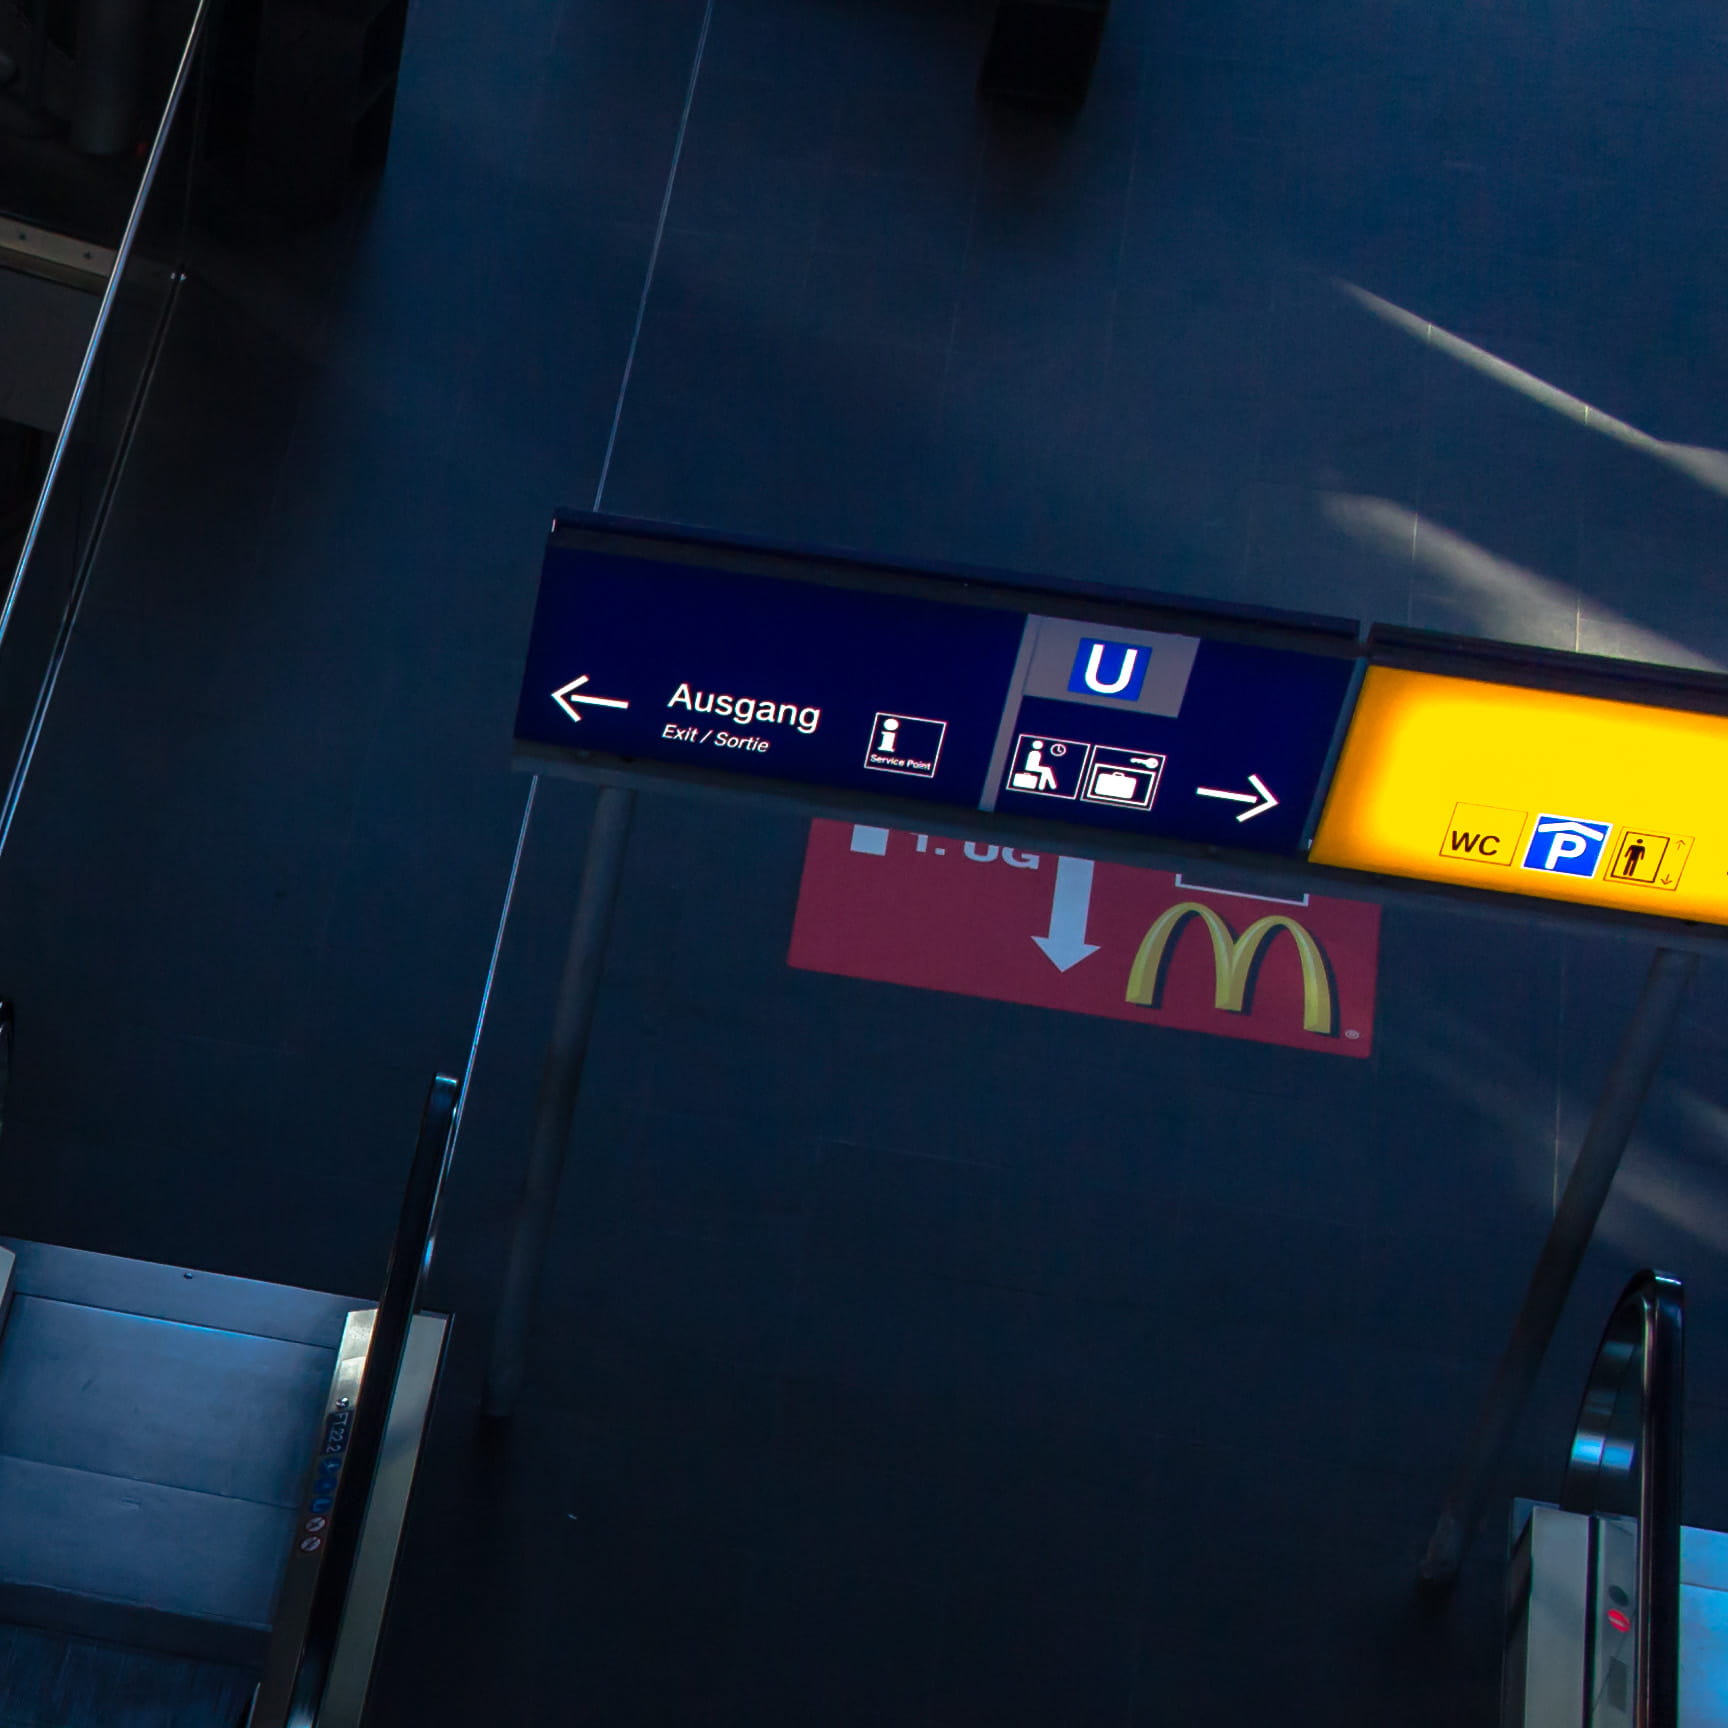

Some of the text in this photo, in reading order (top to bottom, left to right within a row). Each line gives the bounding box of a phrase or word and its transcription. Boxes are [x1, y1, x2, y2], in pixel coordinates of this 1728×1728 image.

[1082, 642, 1139, 696] U
[667, 682, 822, 734] Ausgang
[661, 723, 699, 743] Exit
[714, 731, 770, 753] Sortie
[870, 754, 932, 771] Service Point
[1451, 830, 1501, 857] WC
[1545, 831, 1588, 870] P
